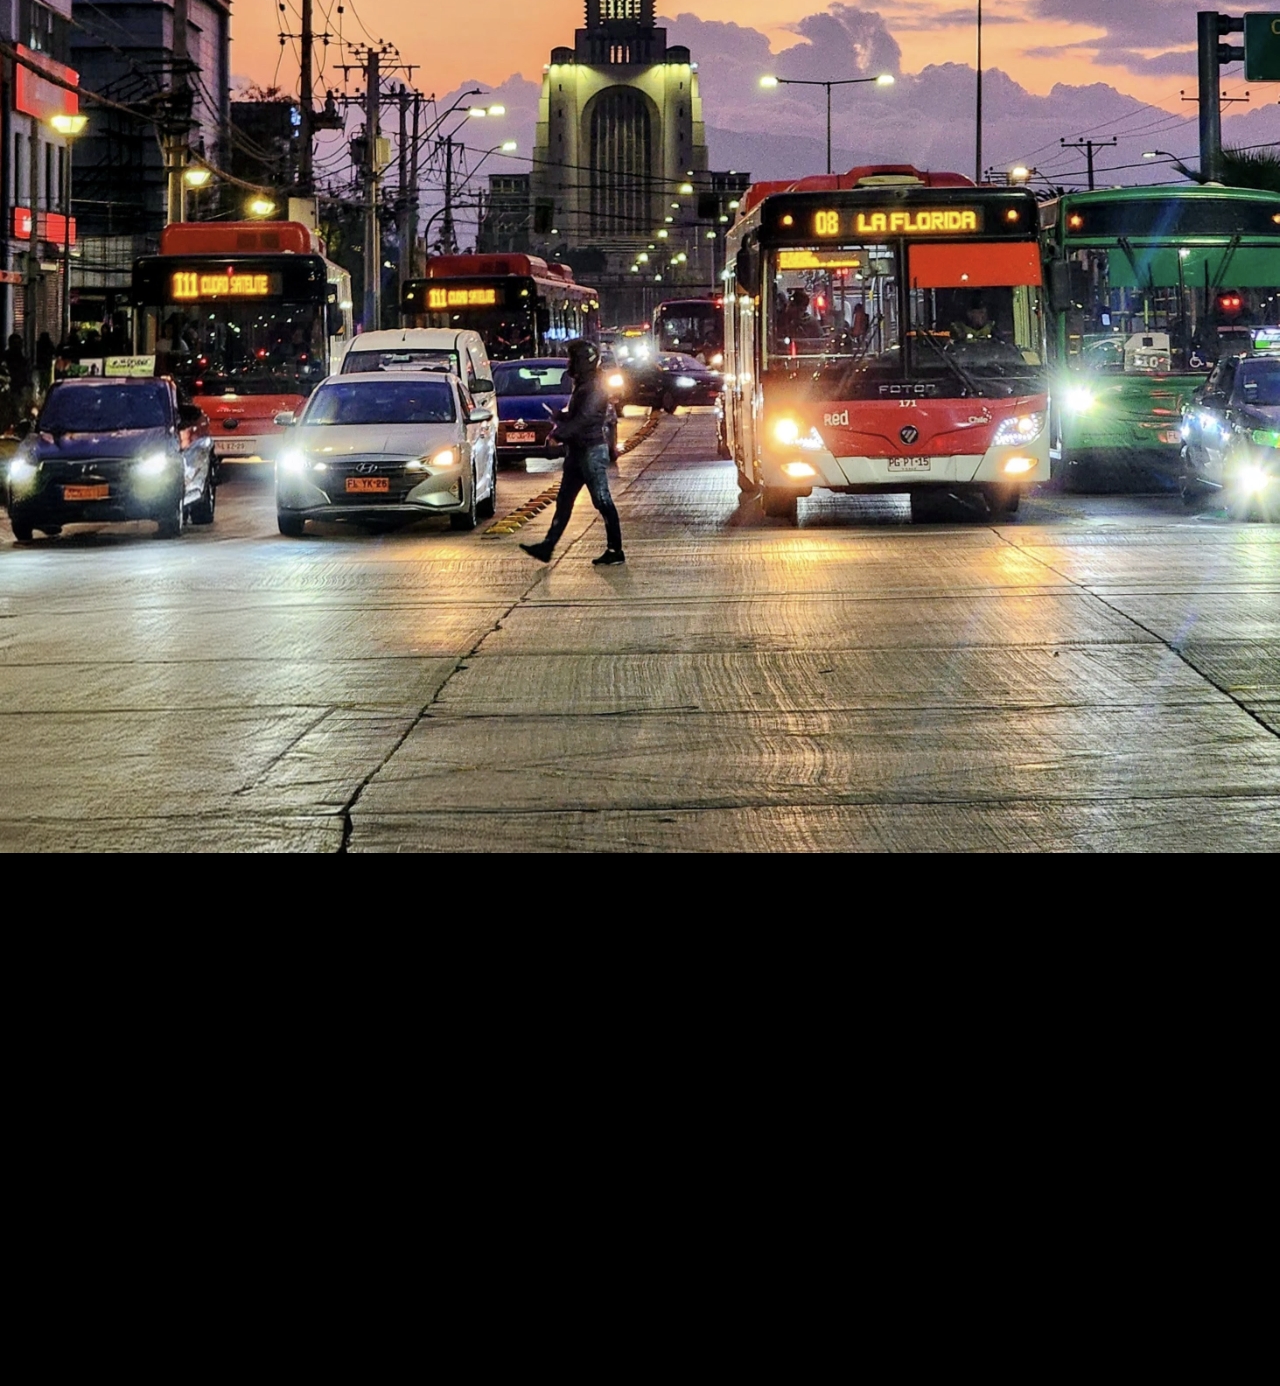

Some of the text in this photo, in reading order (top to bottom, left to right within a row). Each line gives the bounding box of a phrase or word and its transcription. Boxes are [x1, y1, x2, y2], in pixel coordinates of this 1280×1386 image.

[815, 210, 976, 235] 08 LA FLORIDA
[173, 272, 199, 298] 111
[429, 288, 447, 308] 111
[878, 384, 935, 394] FOTON
[899, 399, 917, 407] 171
[824, 410, 849, 426] Red
[968, 415, 988, 424] Chile
